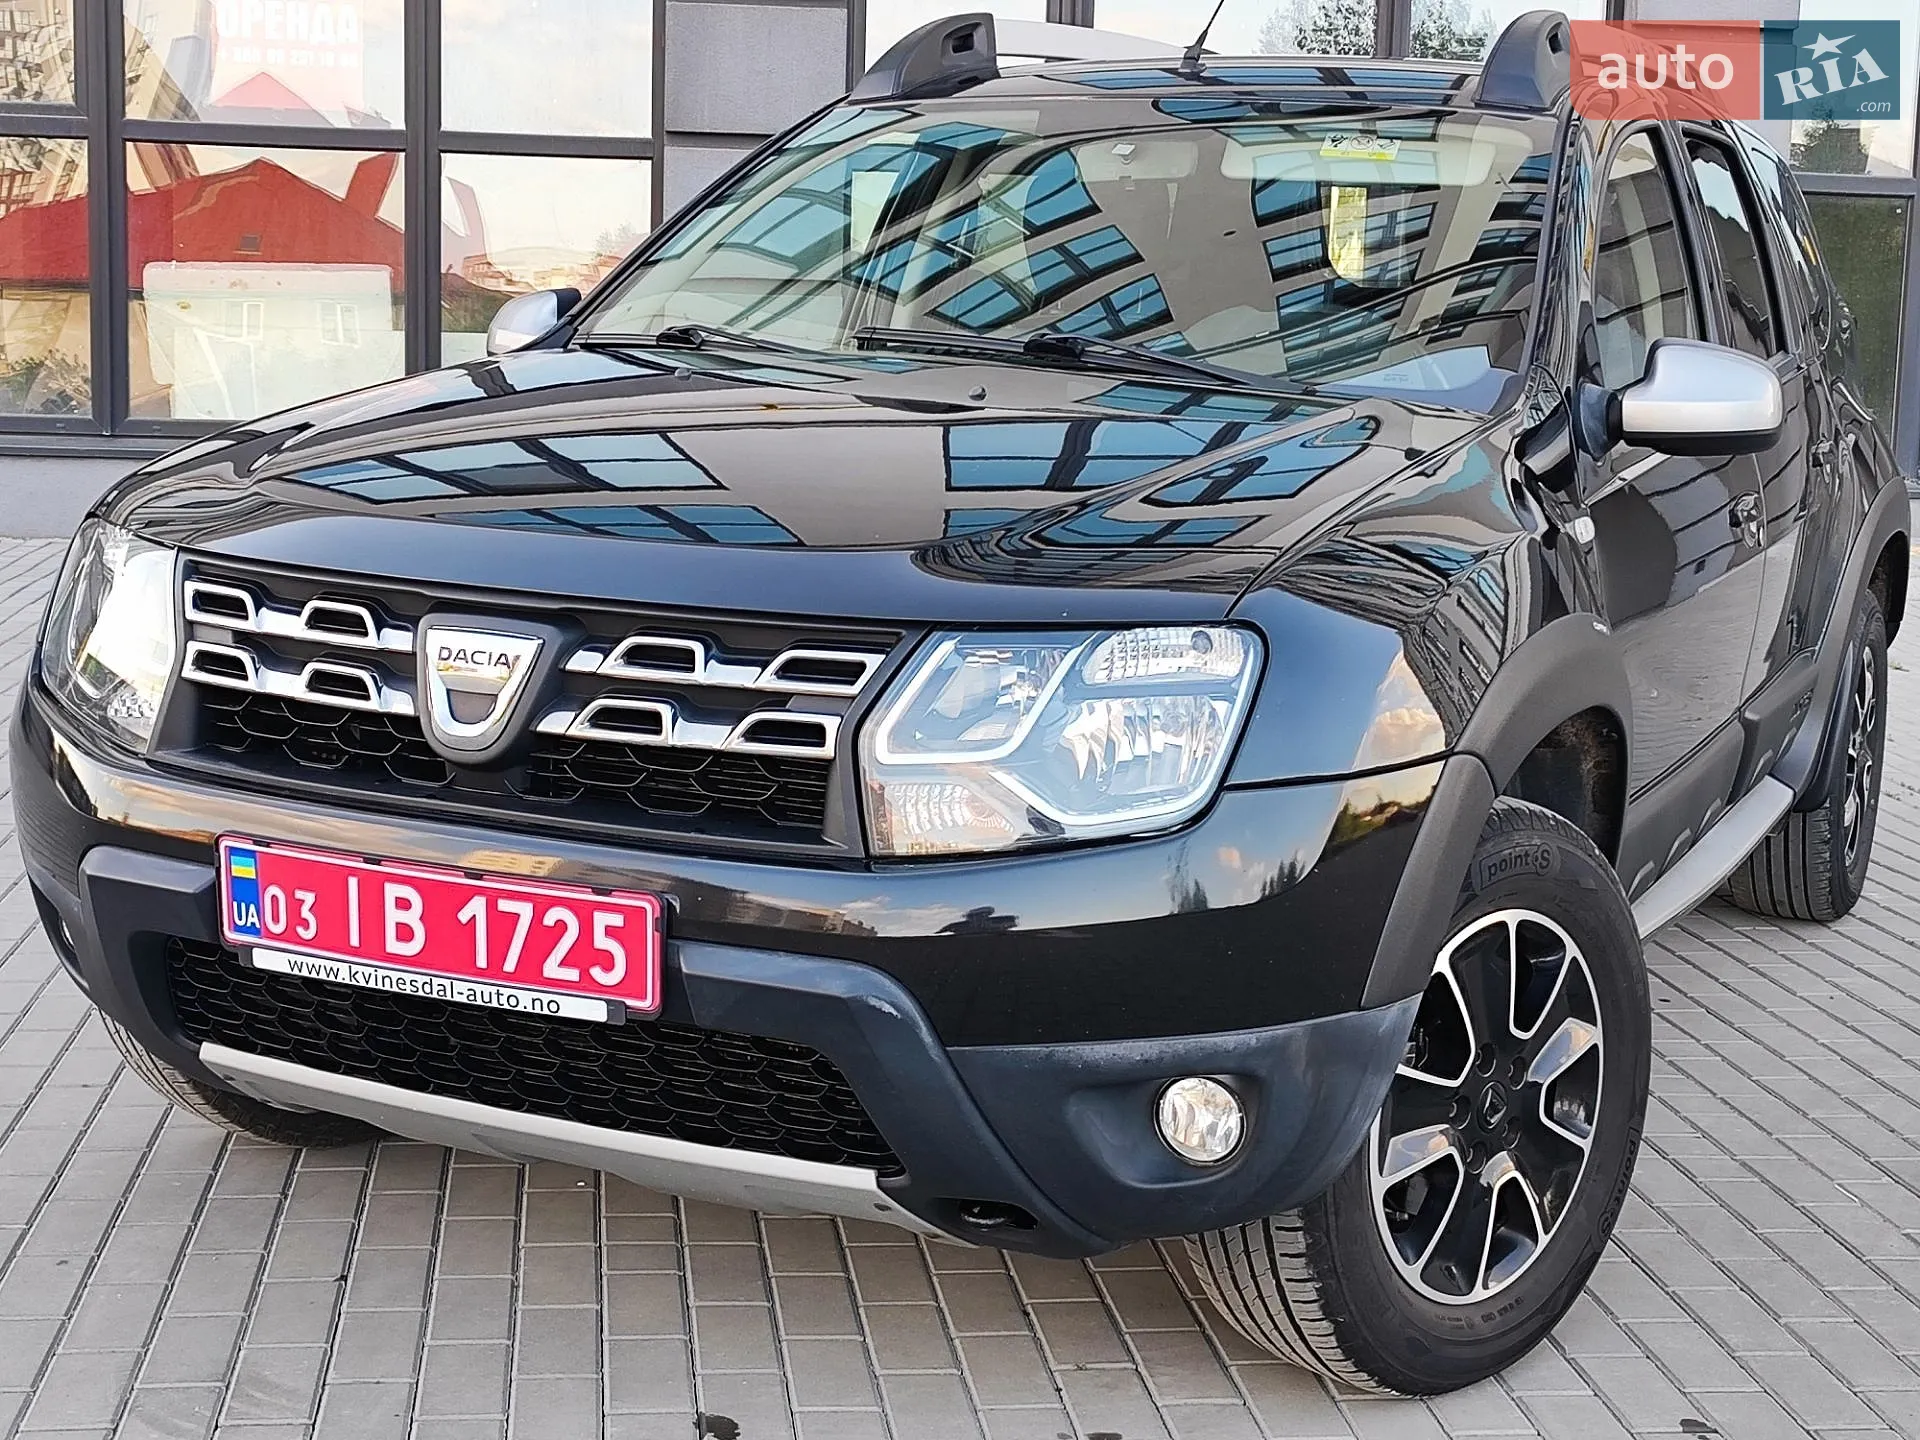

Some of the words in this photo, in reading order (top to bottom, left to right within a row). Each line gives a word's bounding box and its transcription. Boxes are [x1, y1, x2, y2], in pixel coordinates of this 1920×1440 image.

[217, 0, 359, 45] ОРЕНДА
[437, 646, 512, 669] DACIA
[232, 900, 261, 928] UA
[456, 895, 627, 986] 1725
[287, 957, 560, 1014] www.kvinesdal-auto.no
